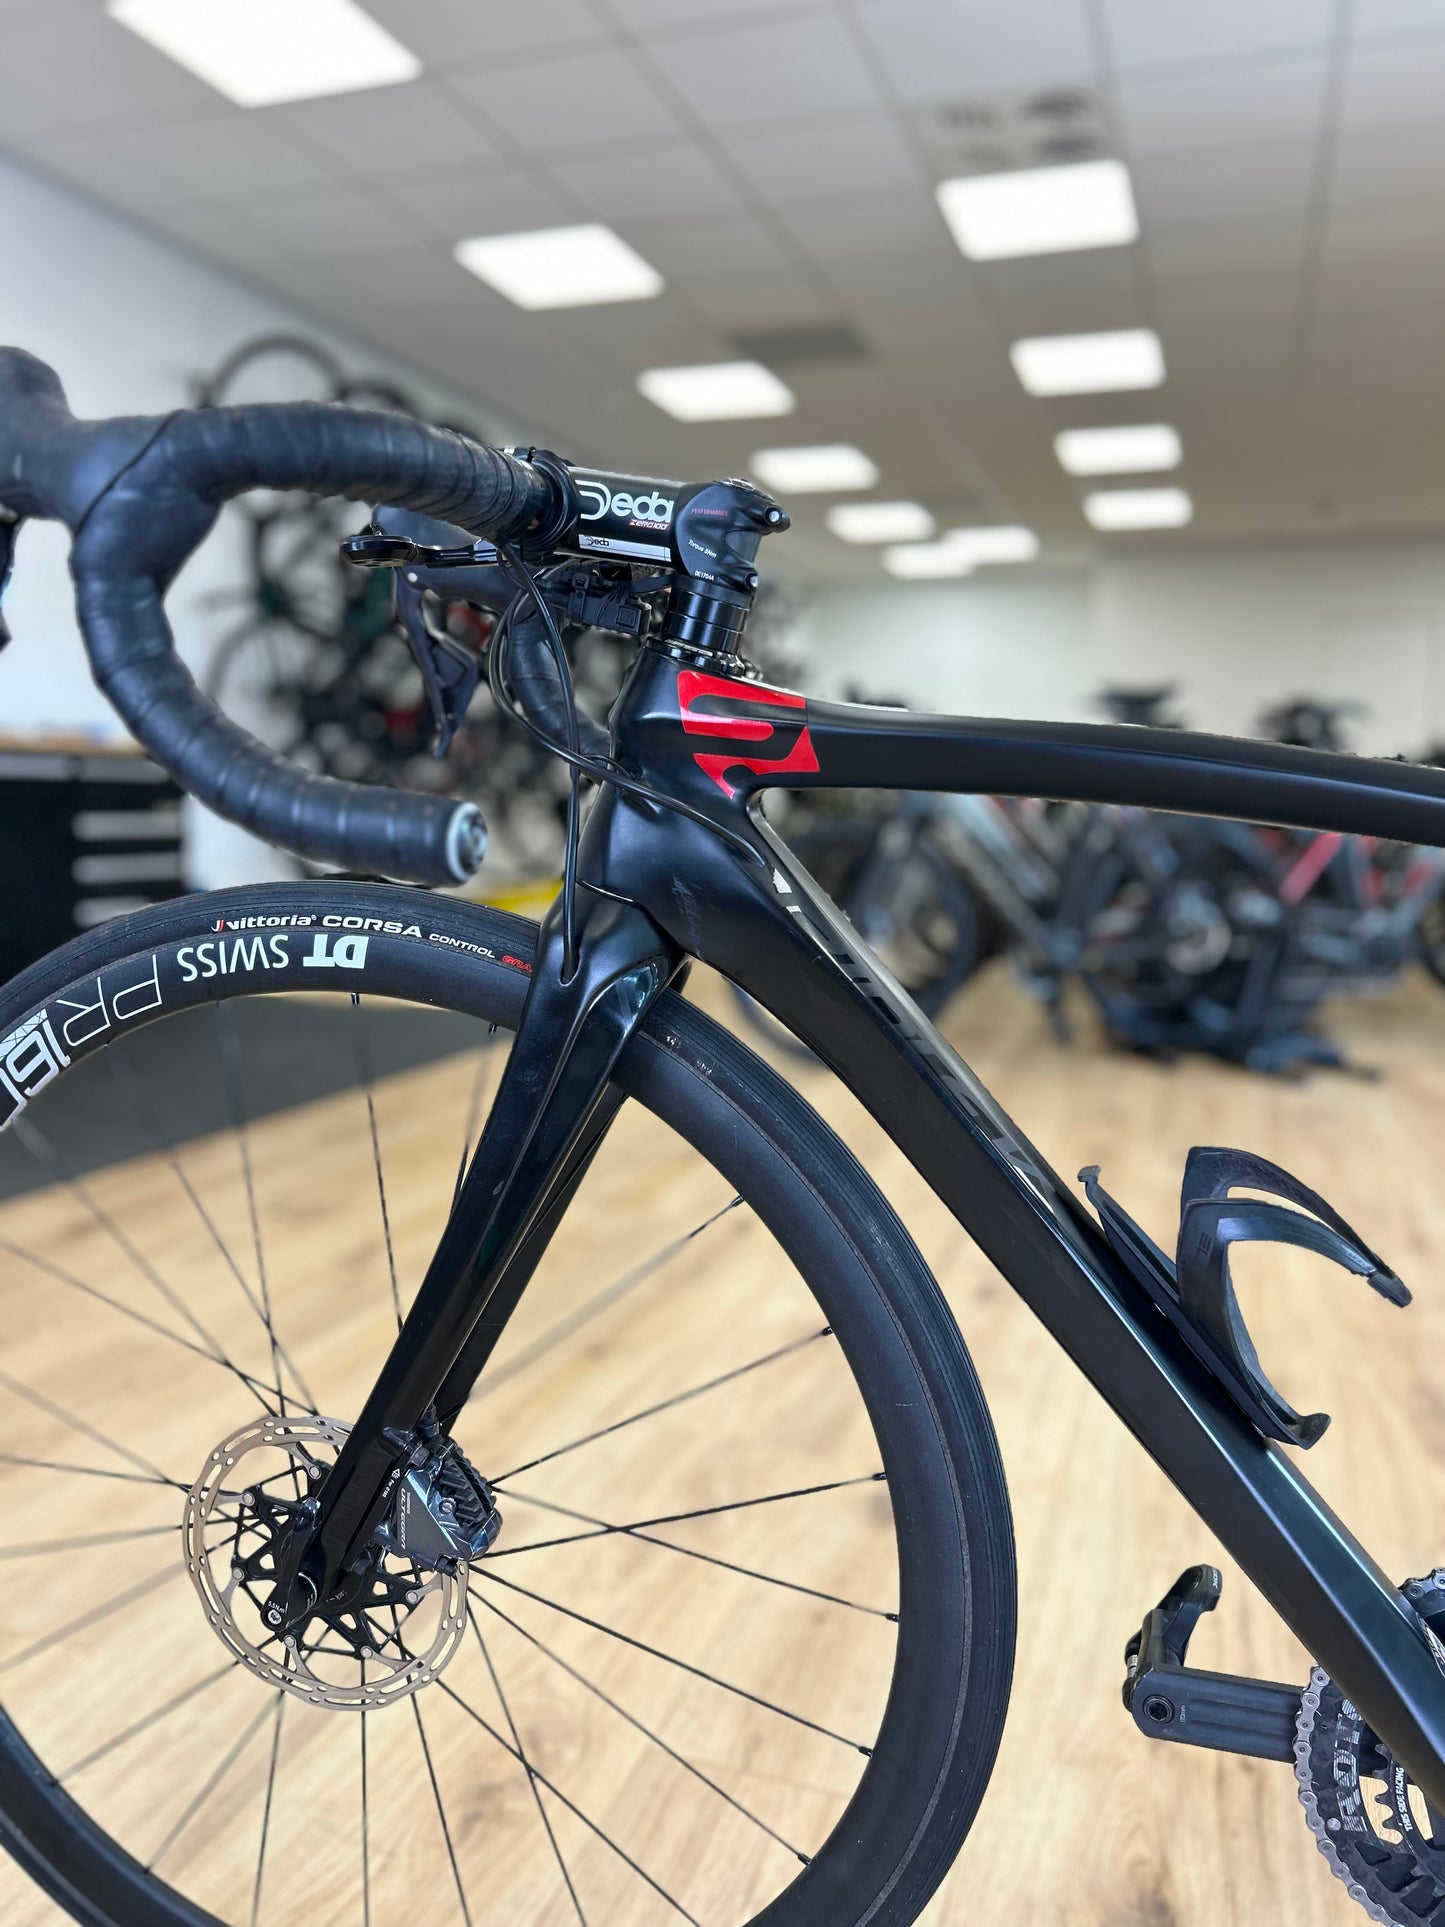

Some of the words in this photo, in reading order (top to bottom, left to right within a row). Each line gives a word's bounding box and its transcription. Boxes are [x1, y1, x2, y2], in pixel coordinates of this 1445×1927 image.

[575, 479, 675, 523] Deda
[585, 536, 610, 547] Deda
[302, 933, 370, 969] DT
[322, 915, 423, 939] CORSA
[428, 932, 496, 959] CONTROL
[176, 934, 290, 983] SWISS
[1394, 1766, 1405, 1795] FACING
[1396, 1794, 1408, 1813] SIDE
[1400, 1812, 1414, 1832] THIS
